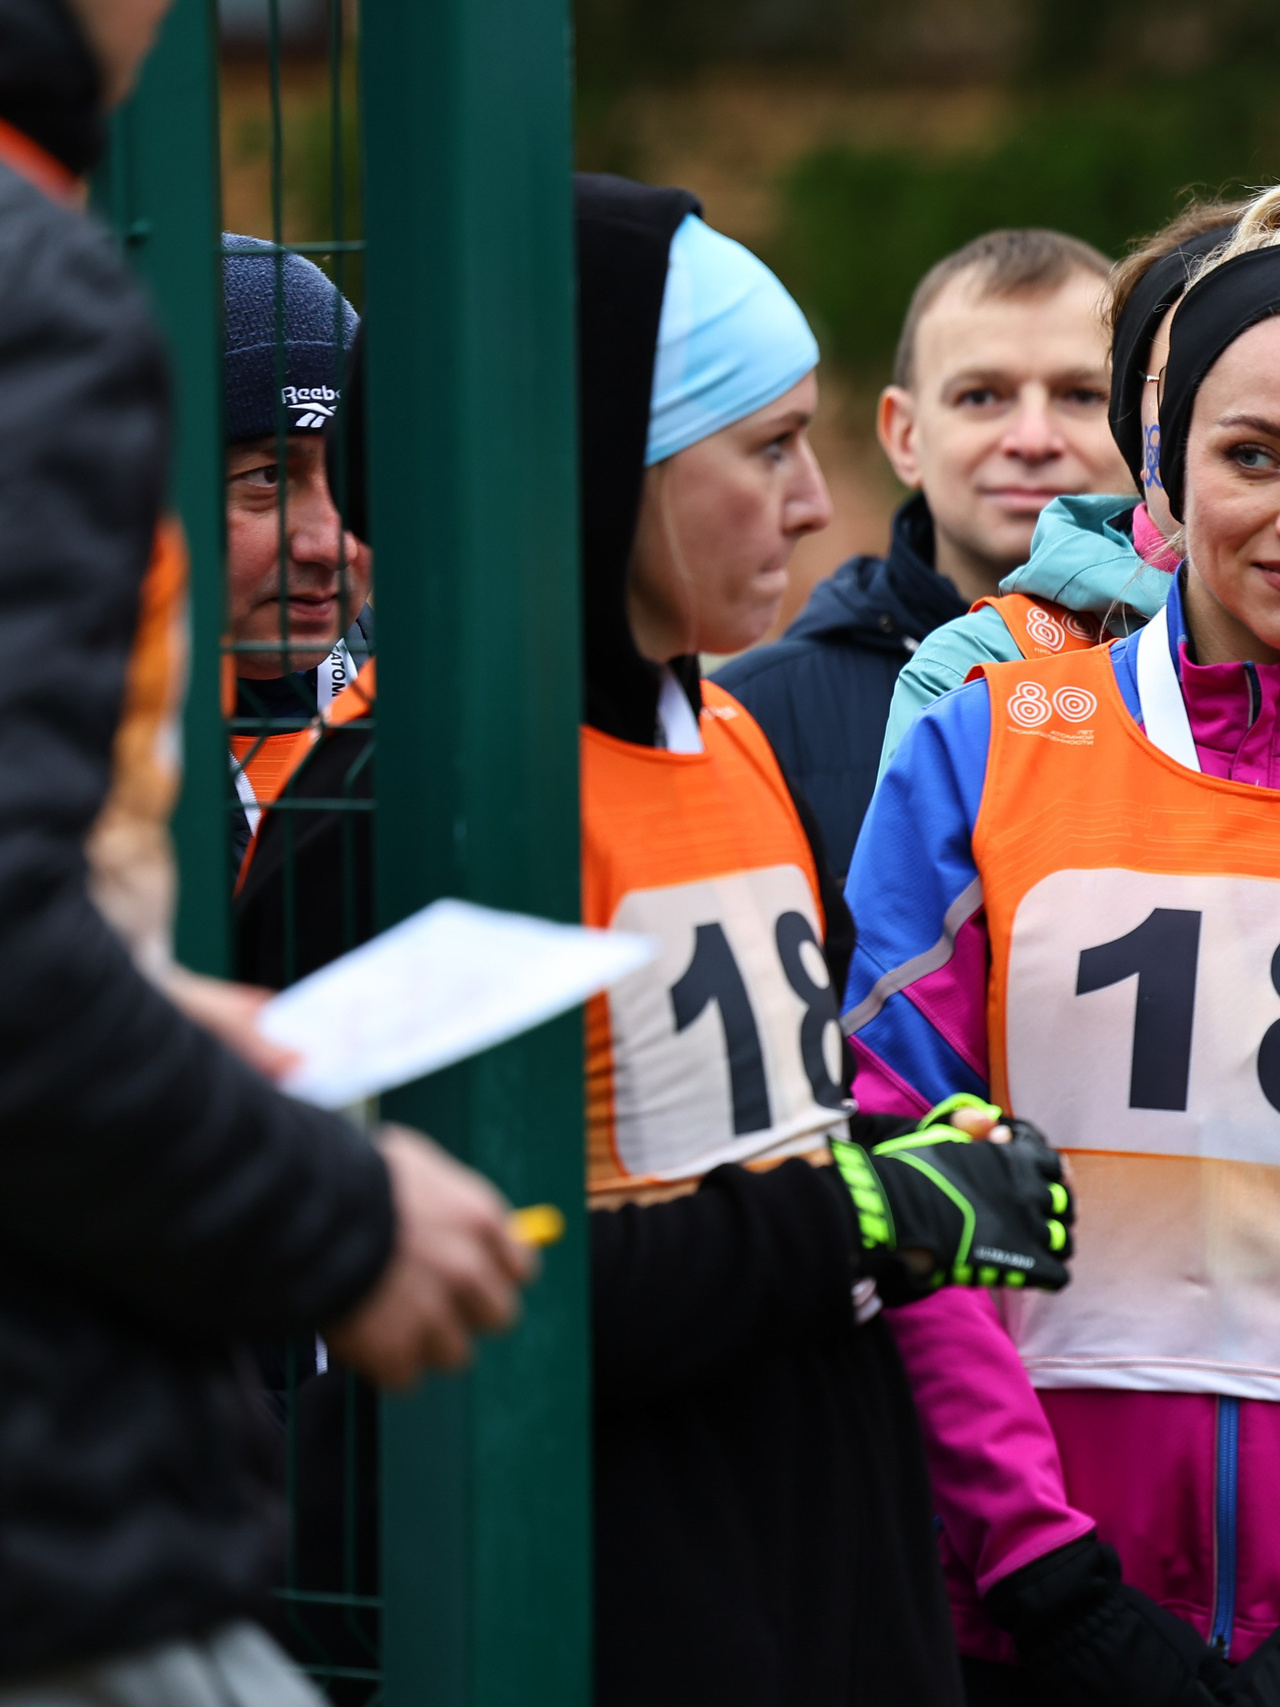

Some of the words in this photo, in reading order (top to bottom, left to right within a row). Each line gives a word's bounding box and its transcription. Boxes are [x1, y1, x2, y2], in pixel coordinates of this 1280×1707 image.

[281, 385, 341, 404] Reeb
[331, 646, 346, 697] АТОМ
[1007, 681, 1097, 728] 80
[670, 911, 858, 1138] 18
